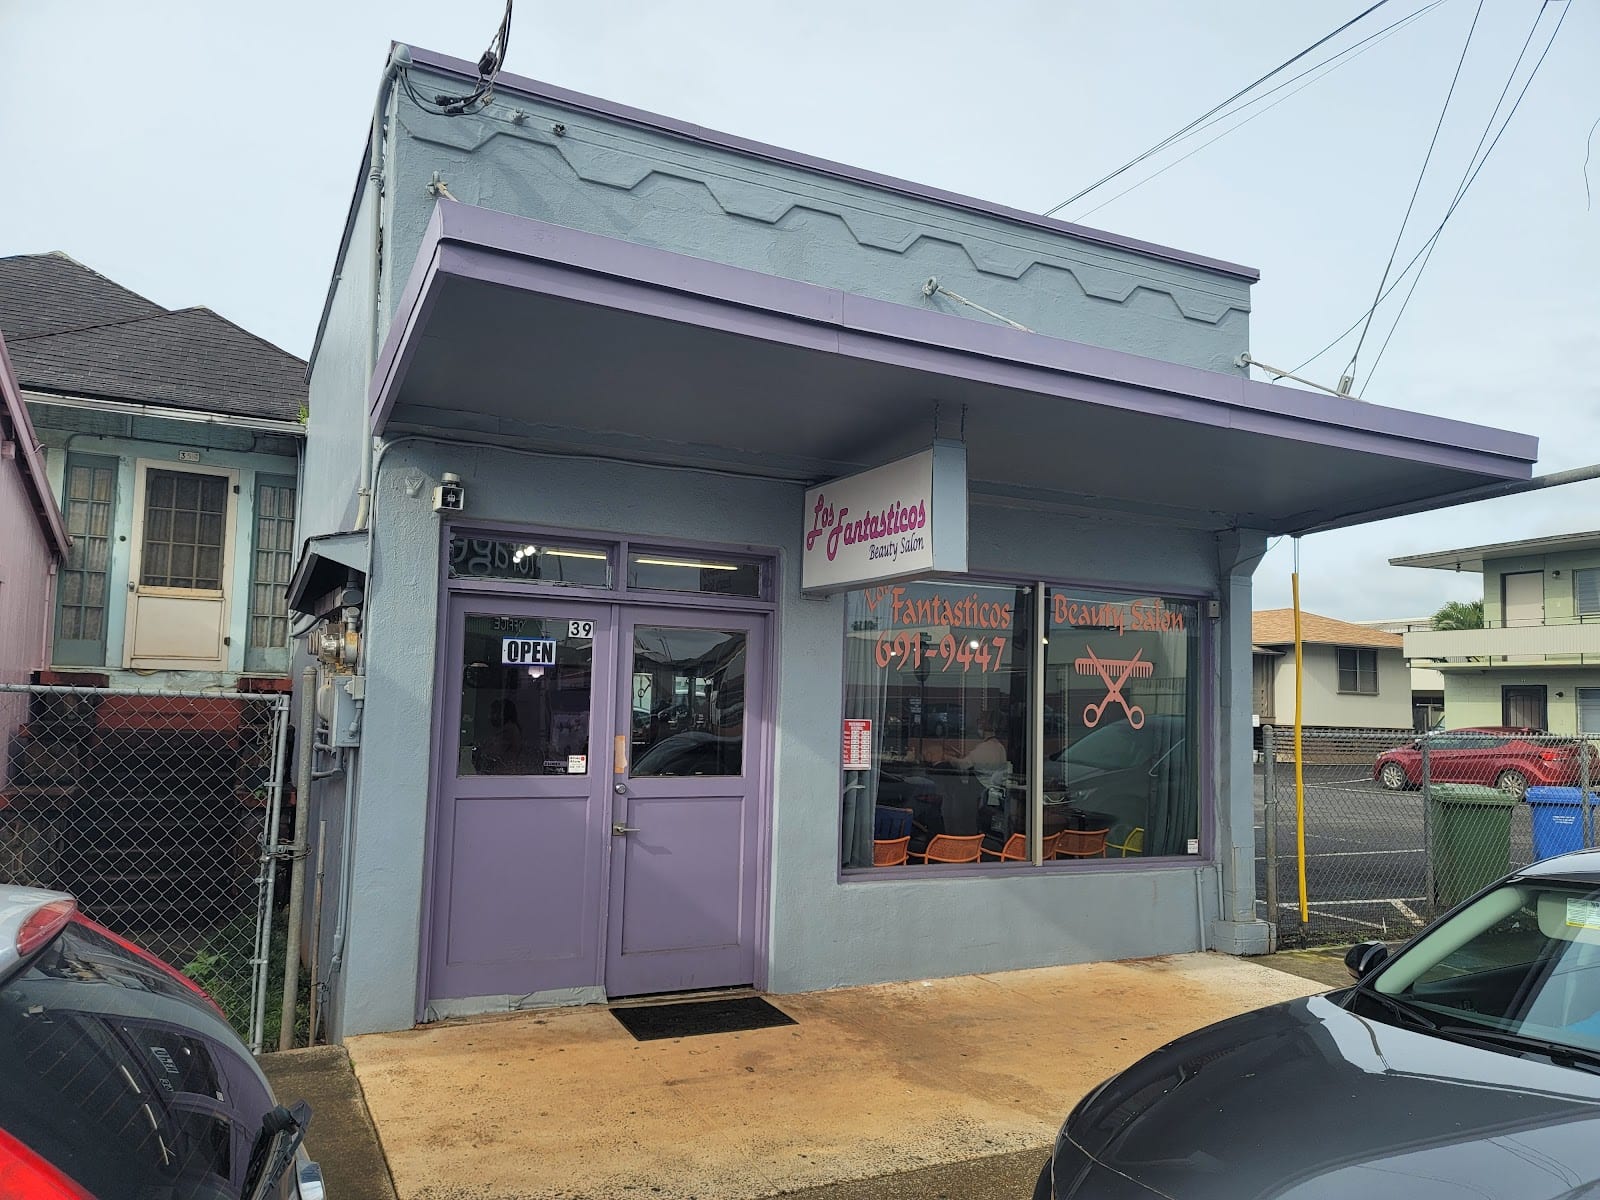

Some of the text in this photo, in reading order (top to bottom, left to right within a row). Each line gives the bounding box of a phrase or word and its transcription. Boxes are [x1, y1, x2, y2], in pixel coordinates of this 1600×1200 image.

[806, 494, 925, 561] Los Fantasticos
[869, 532, 924, 562] Beauty Salon
[892, 588, 1011, 628] Fantasticos
[1053, 594, 1184, 636] Beauty Salon
[571, 622, 592, 637] 39
[508, 641, 553, 662] OPEN
[875, 631, 1007, 672] 691-9447
